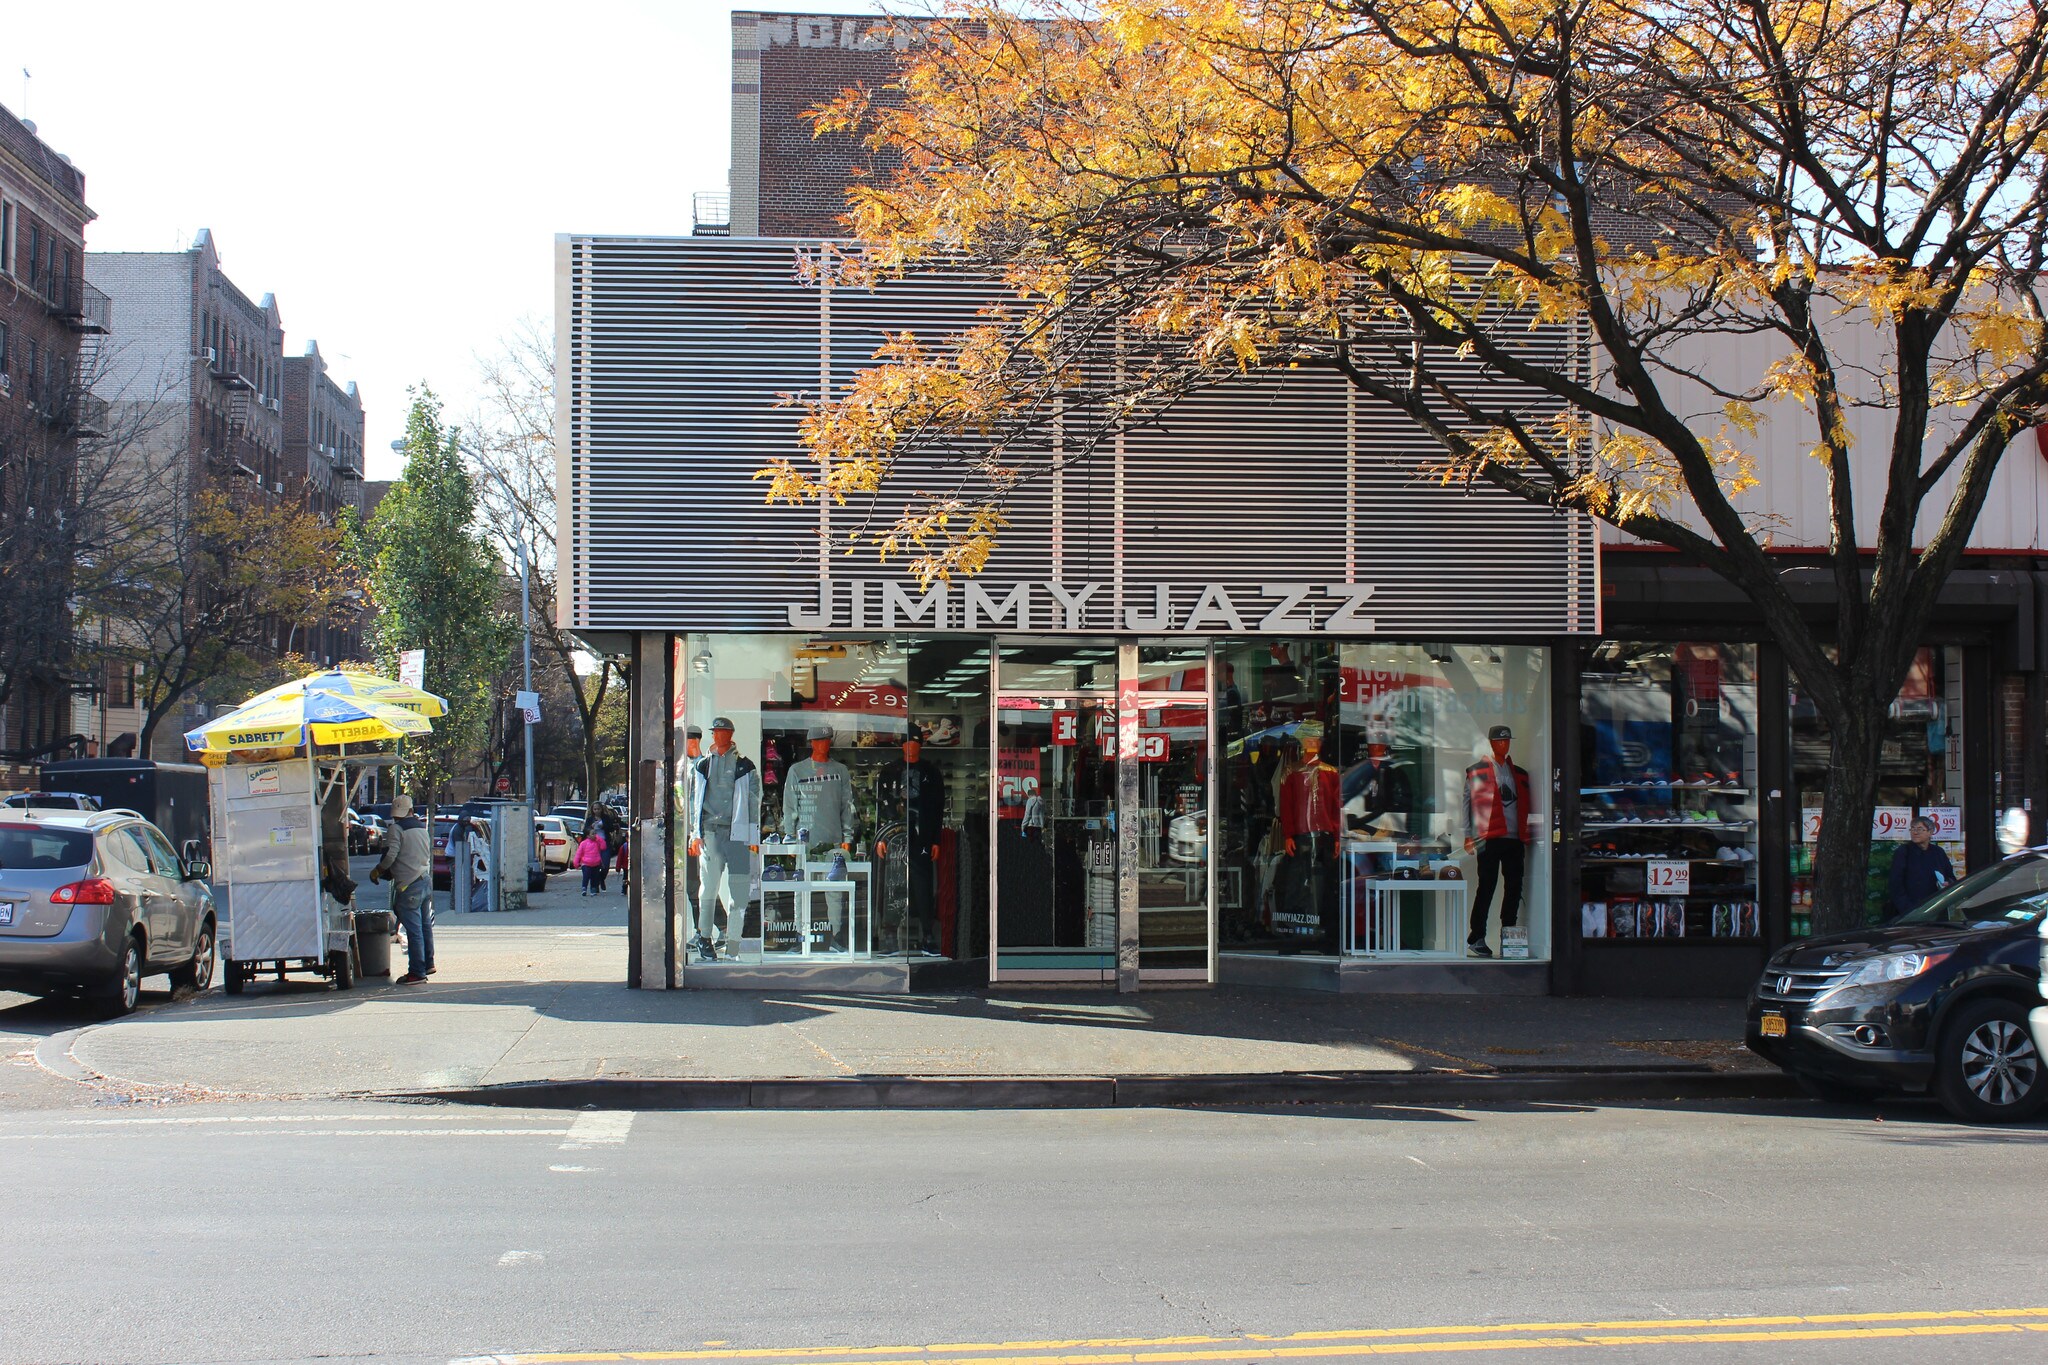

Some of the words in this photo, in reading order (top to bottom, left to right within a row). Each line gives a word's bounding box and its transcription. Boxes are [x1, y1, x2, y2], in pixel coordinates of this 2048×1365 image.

[788, 579, 1102, 629] JIMMY
[1125, 583, 1376, 632] JAZZ
[1357, 664, 1407, 682] New
[1357, 683, 1426, 718] Flight
[228, 731, 285, 745] SABRETT
[249, 766, 278, 782] SABRETT
[1271, 912, 1320, 925] JIMMYJAZZ.COM
